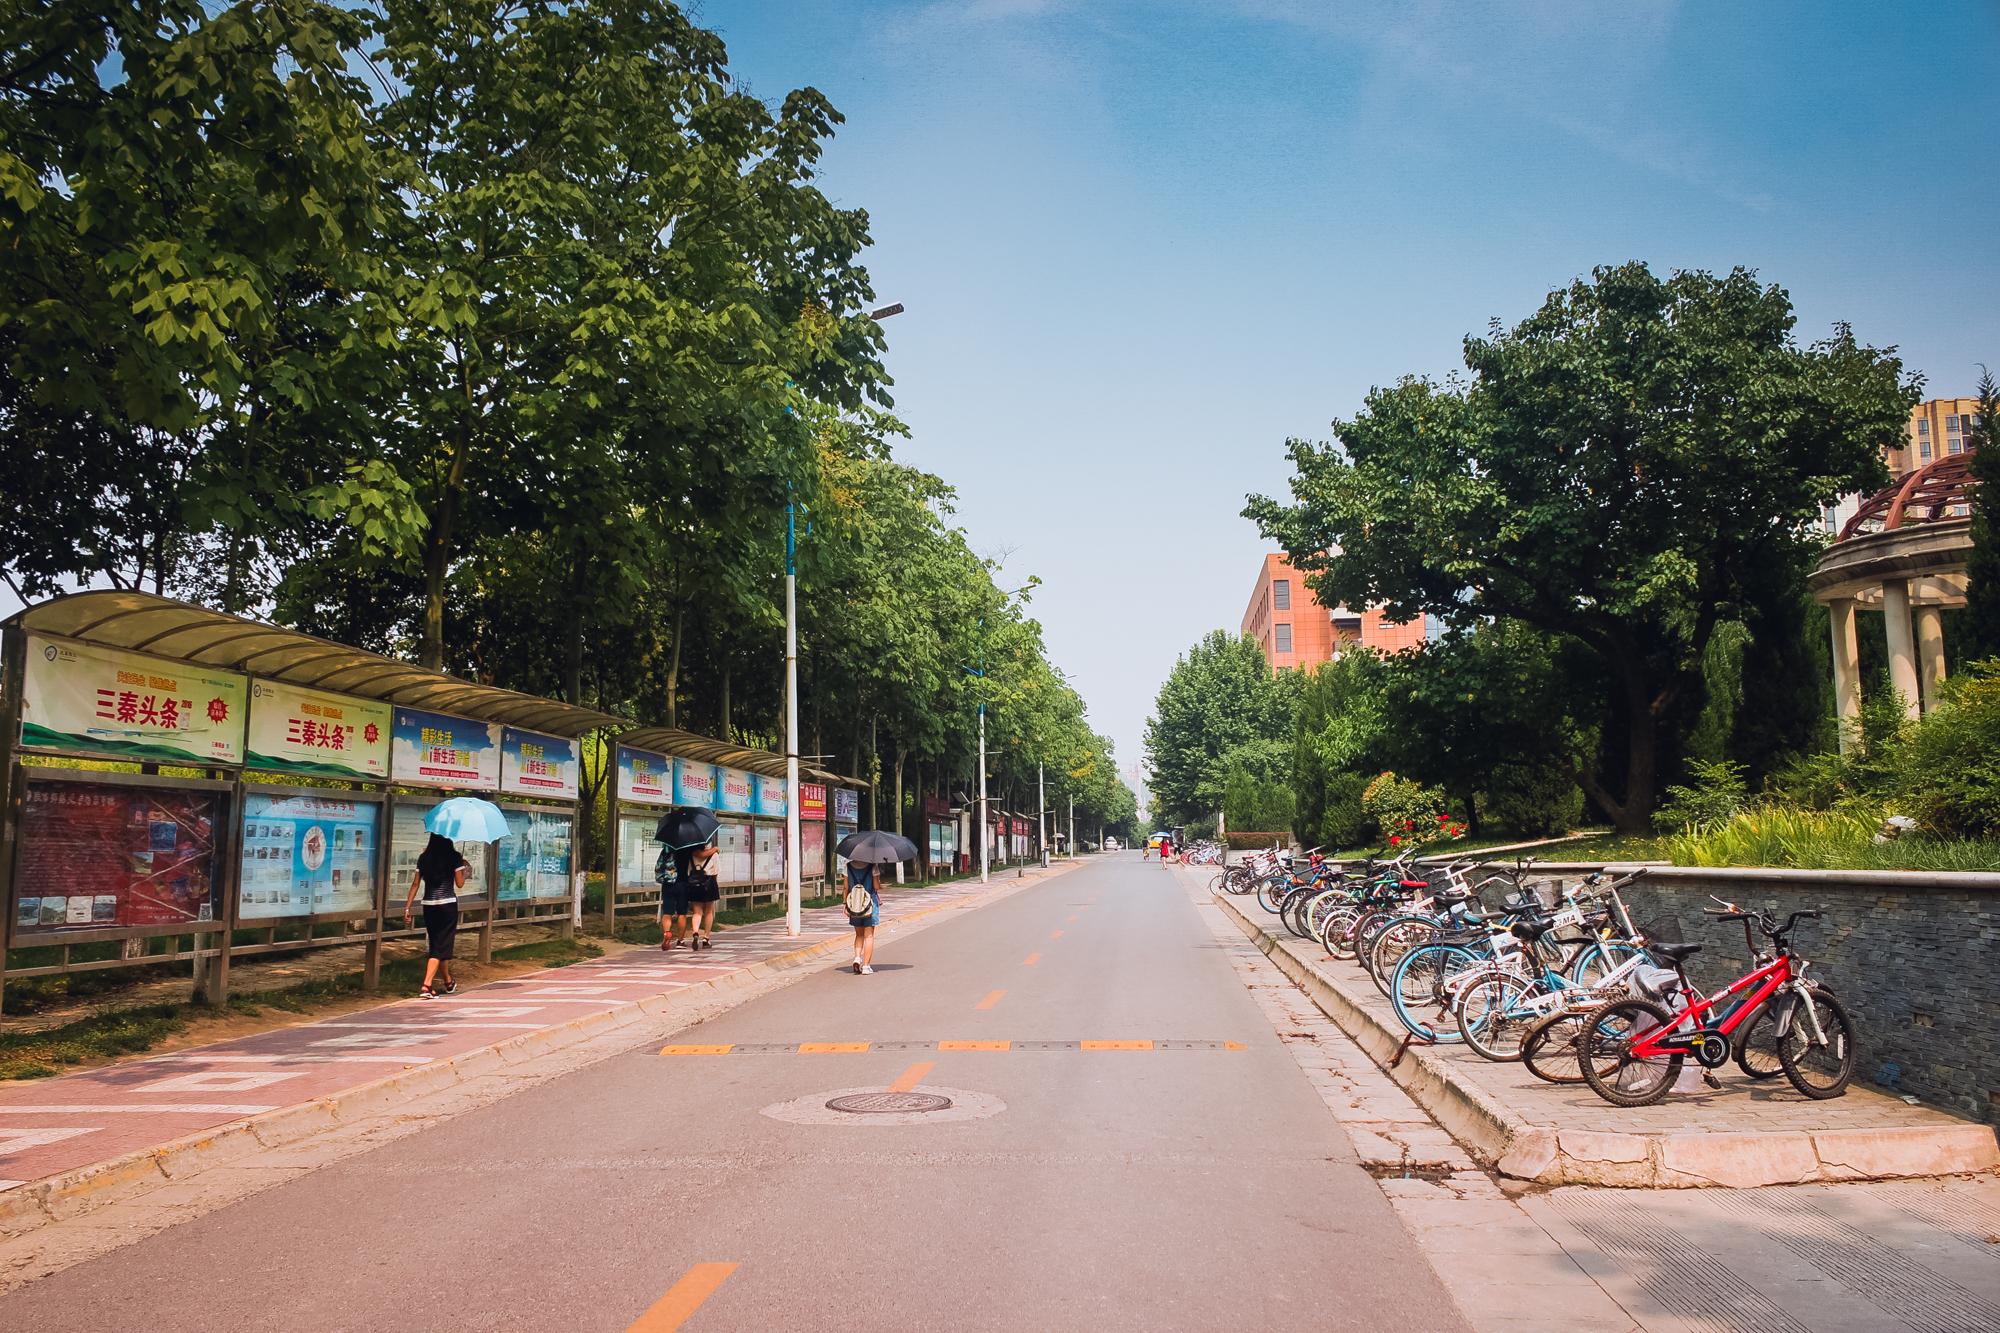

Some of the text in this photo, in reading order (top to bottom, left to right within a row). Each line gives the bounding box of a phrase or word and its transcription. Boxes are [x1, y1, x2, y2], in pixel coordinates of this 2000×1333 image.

[96, 689, 179, 729] 三秦头条
[286, 718, 345, 750] 三秦头条
[421, 727, 452, 746] 精彩生活
